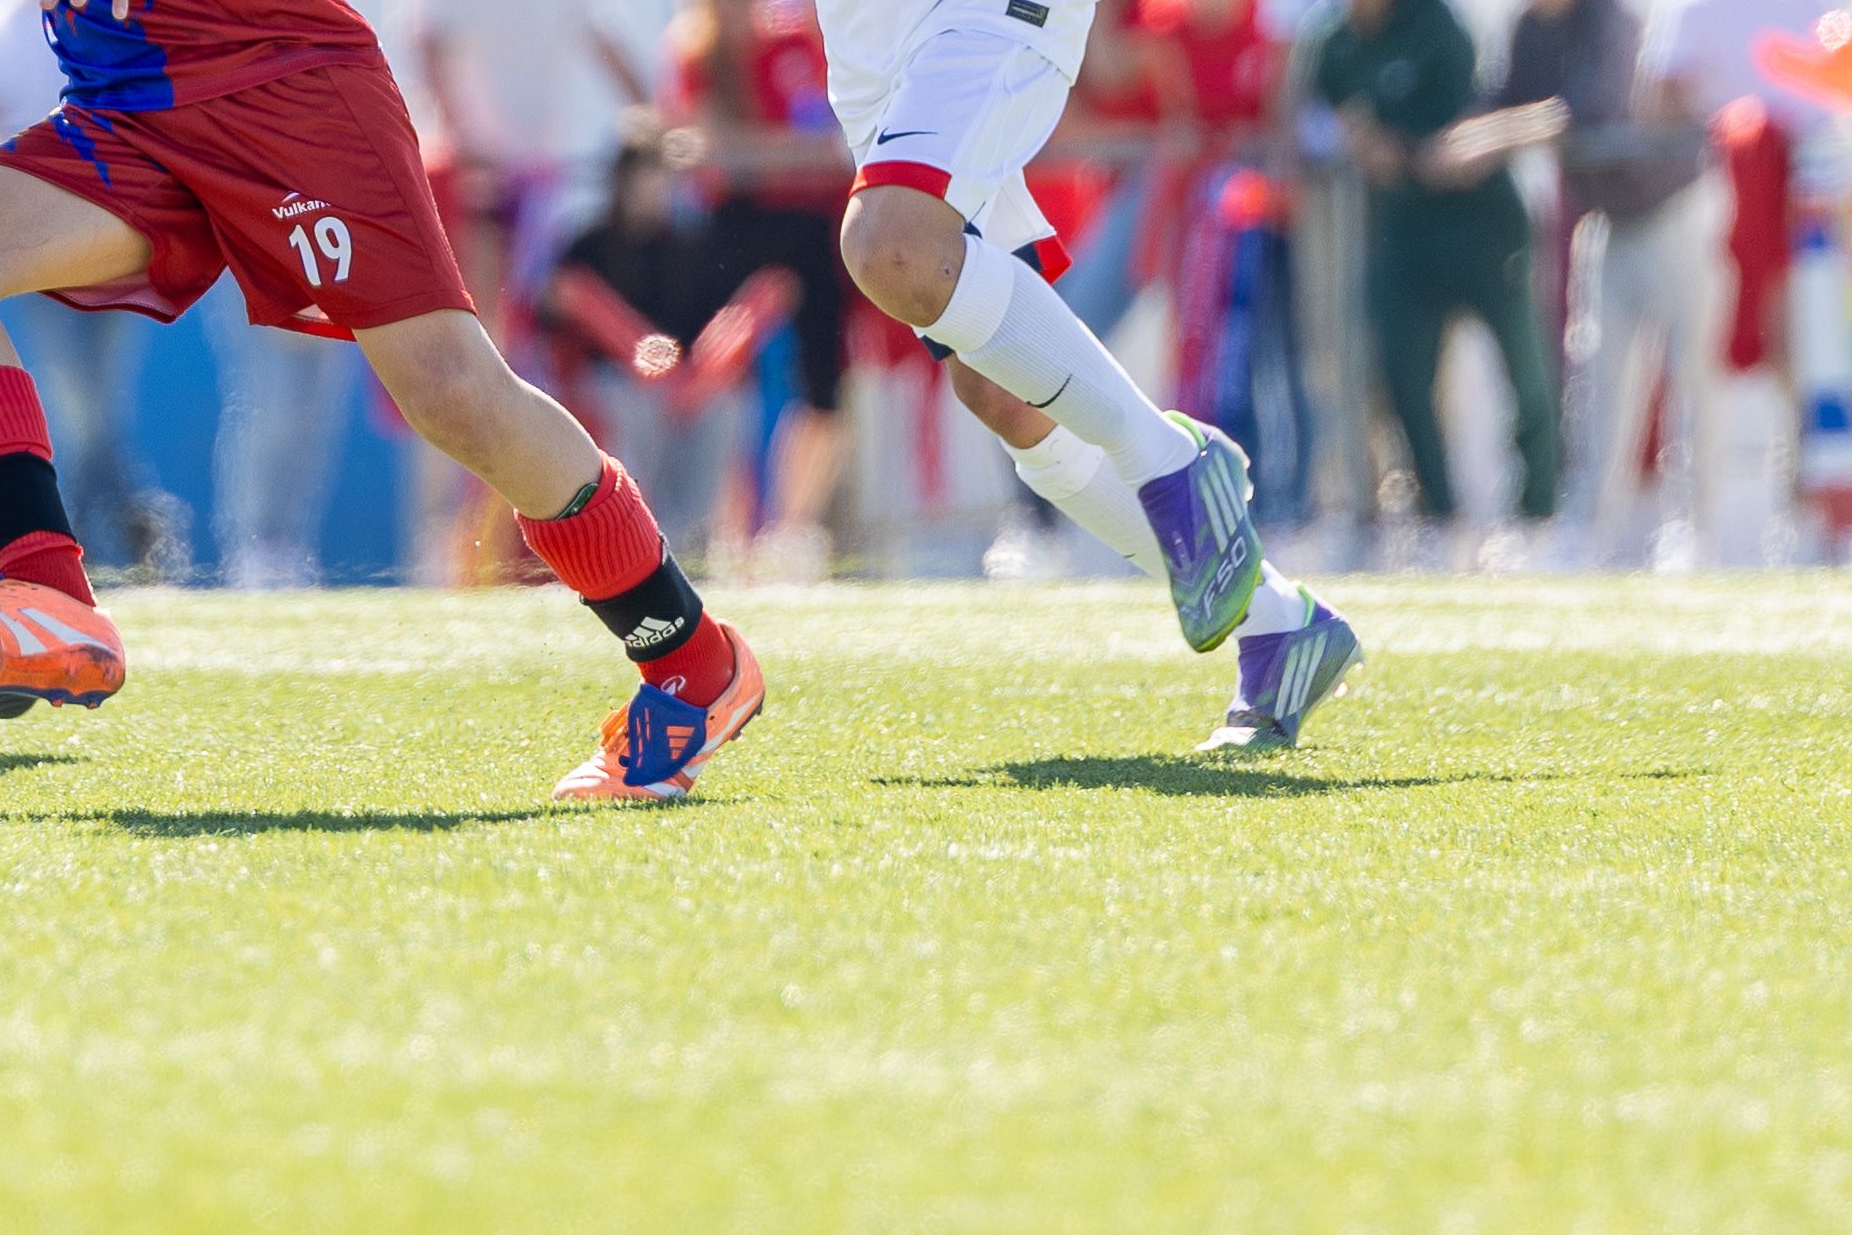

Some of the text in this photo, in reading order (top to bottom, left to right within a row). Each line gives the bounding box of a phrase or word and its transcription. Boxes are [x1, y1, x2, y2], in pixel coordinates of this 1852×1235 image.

[271, 200, 330, 219] Vulkan
[288, 216, 352, 286] 19
[1203, 536, 1248, 621] F50
